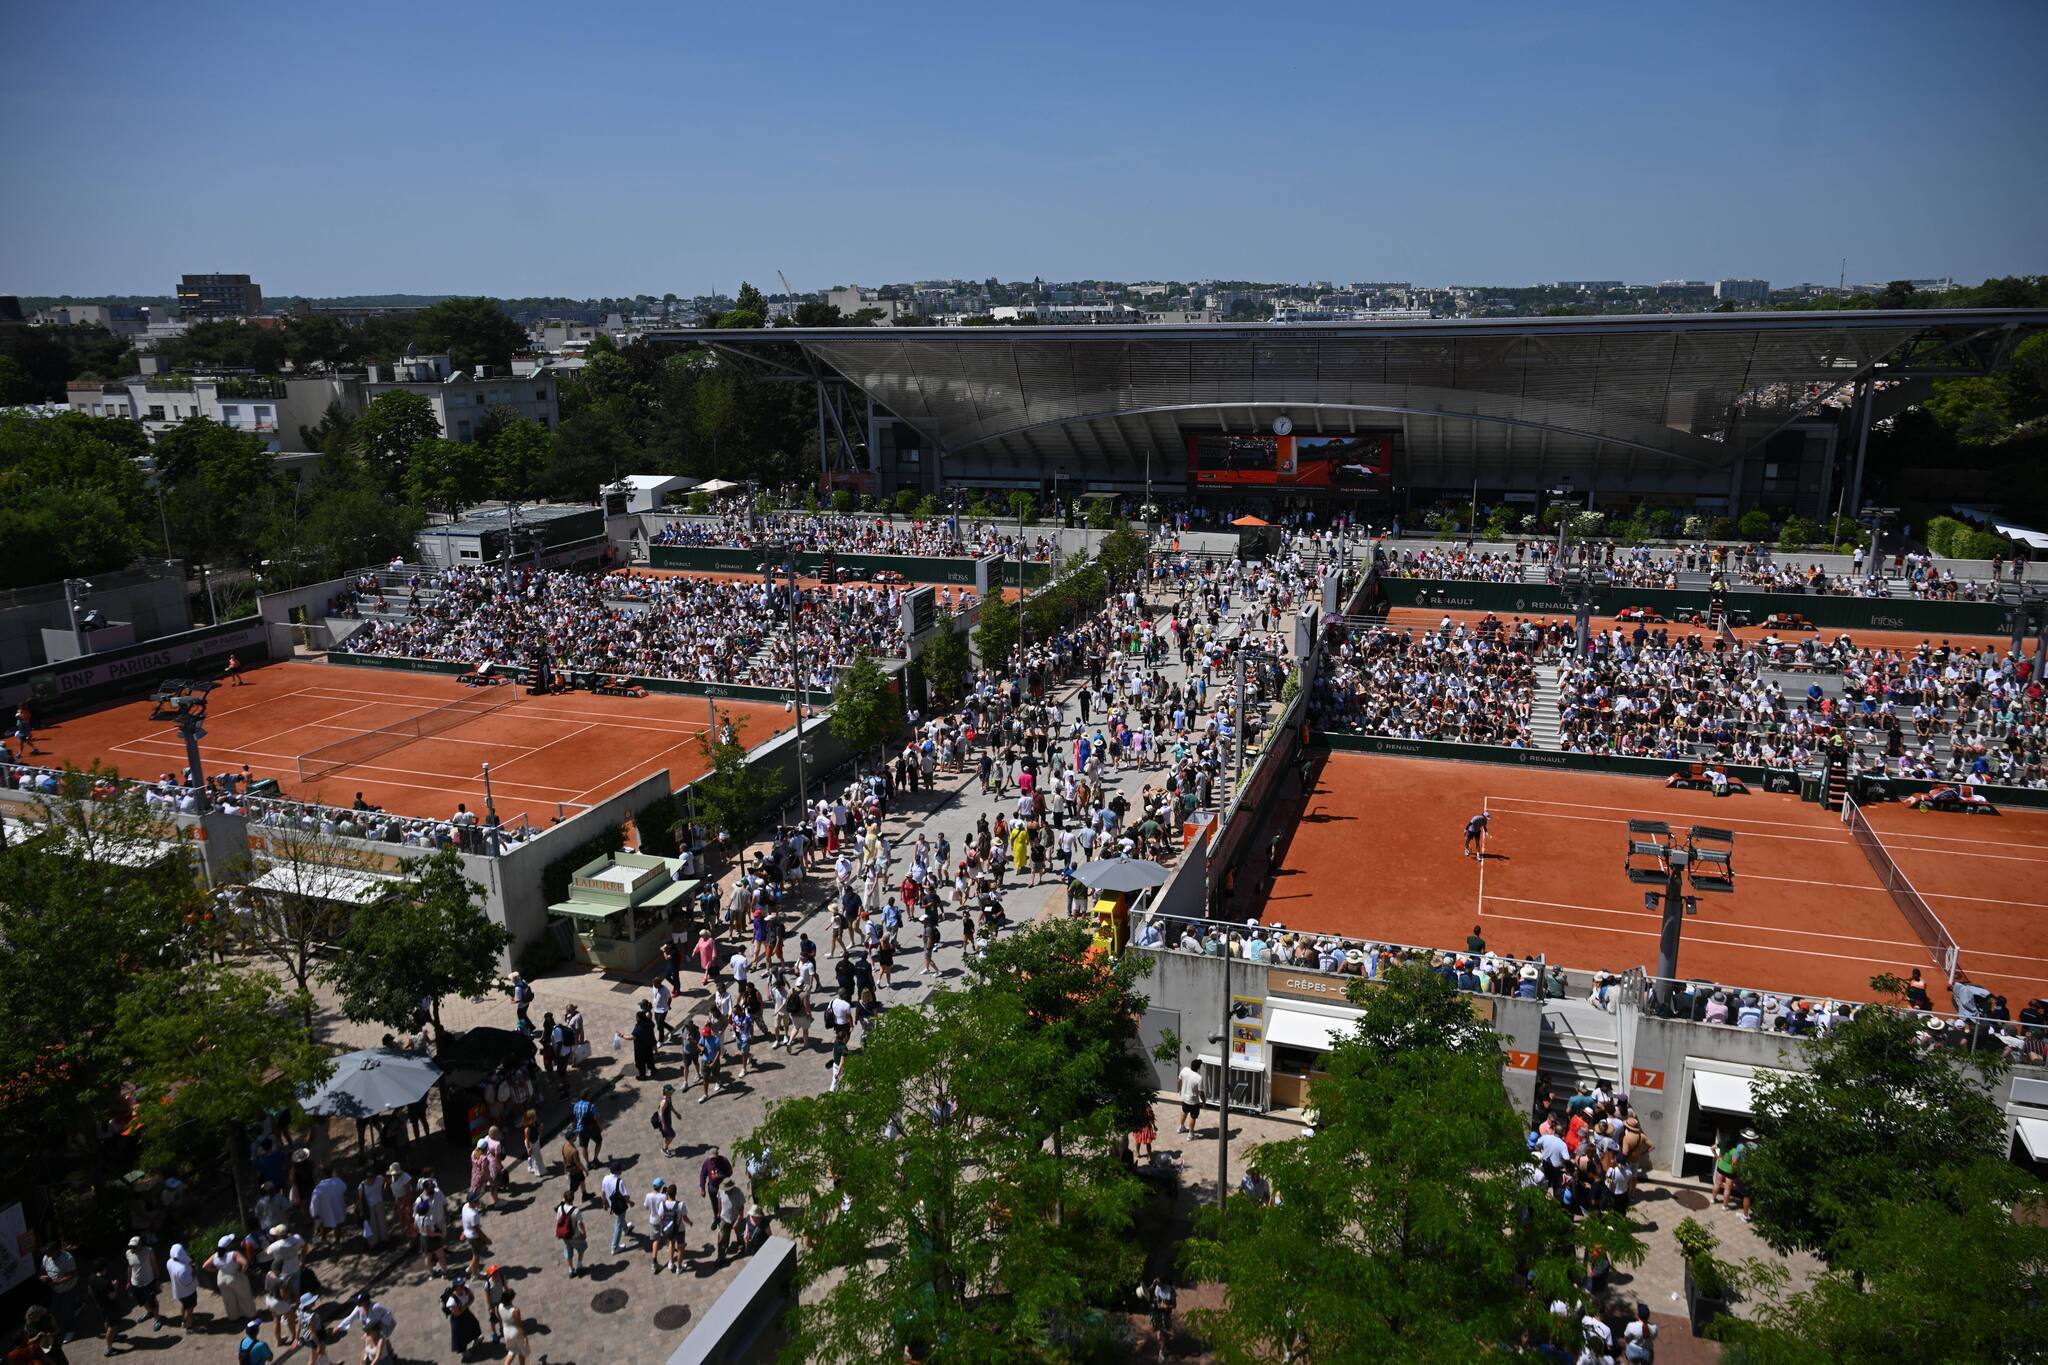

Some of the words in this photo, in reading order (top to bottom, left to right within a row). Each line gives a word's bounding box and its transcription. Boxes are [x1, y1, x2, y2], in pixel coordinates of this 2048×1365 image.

[1870, 615, 1904, 627] Infosys
[61, 670, 94, 691] BNP
[109, 651, 171, 678] PARIBAS
[1385, 743, 1421, 752] RENAULT
[1529, 755, 1566, 764] RENAULT
[1286, 979, 1327, 993] CRÊPES
[1519, 1053, 1530, 1067] 7
[1645, 1071, 1657, 1086] 7
